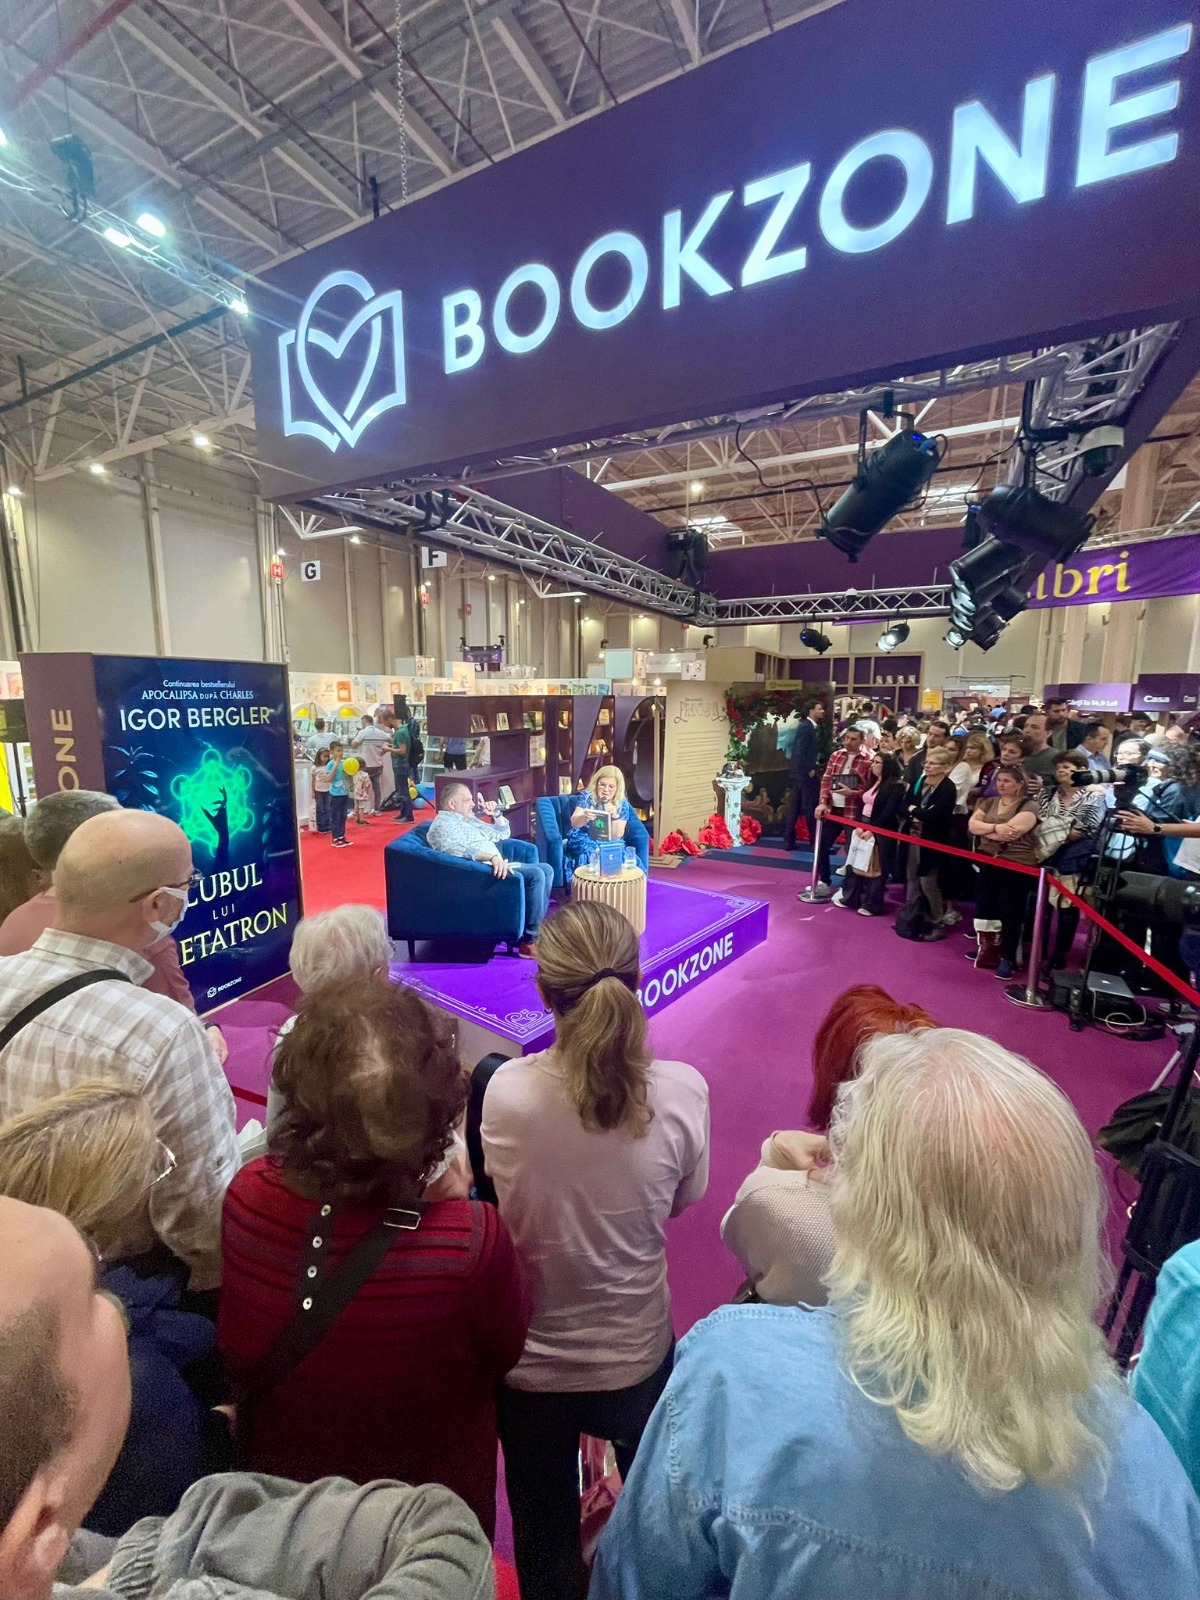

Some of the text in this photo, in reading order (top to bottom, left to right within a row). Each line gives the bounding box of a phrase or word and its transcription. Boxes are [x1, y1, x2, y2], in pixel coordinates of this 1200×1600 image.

[442, 22, 1193, 376] BOOKZONE
[429, 548, 439, 566] F
[304, 562, 317, 580] G
[1027, 551, 1131, 600] ibri
[162, 679, 236, 689] Continuarea bestsellerului
[141, 690, 199, 700] APOCALIPSA
[219, 690, 254, 700] CHARLES
[120, 706, 271, 731] IGOR BERGLER
[212, 903, 235, 919] LUI
[178, 902, 287, 967] ETATRON
[217, 976, 243, 992] BOOKZONE
